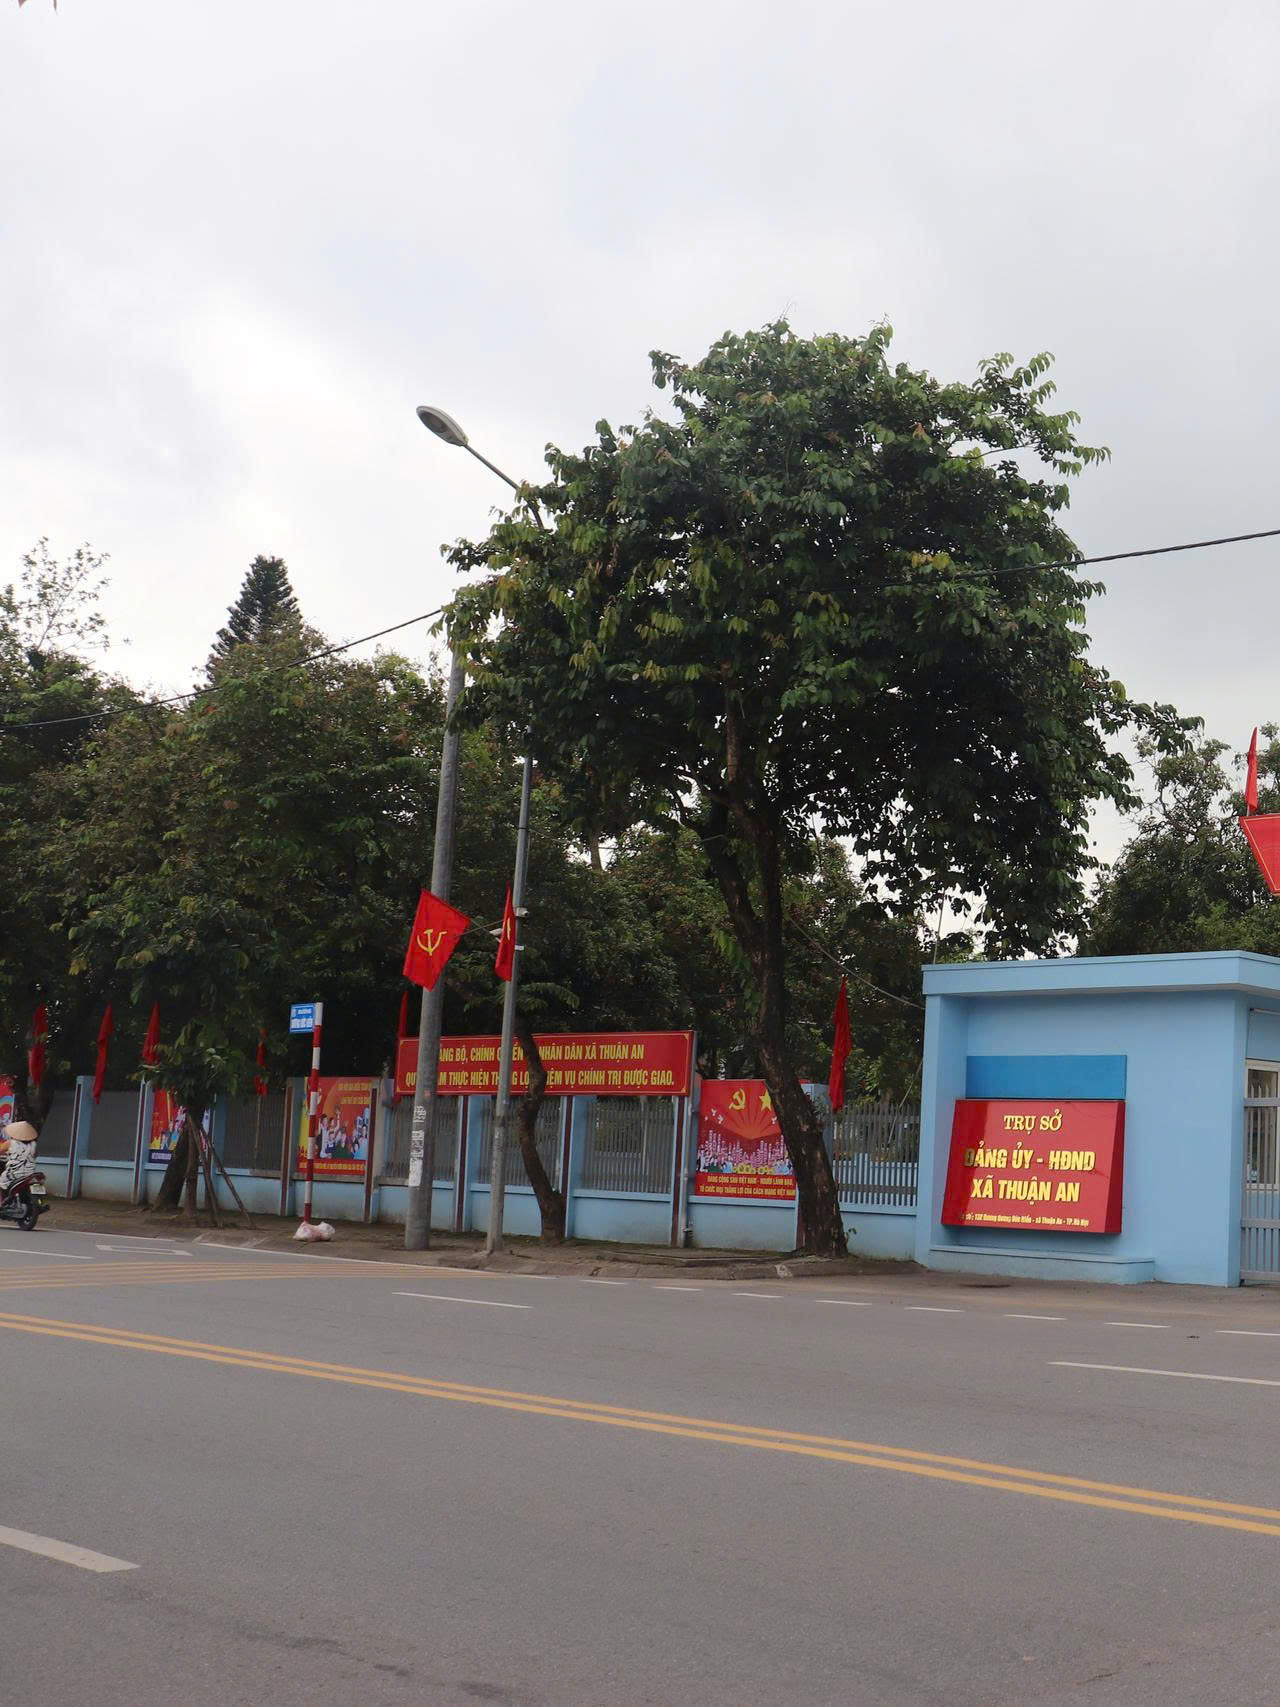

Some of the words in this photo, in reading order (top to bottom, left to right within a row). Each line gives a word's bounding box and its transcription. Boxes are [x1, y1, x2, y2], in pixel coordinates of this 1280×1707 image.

[440, 1043, 454, 1062] ẢNG
[470, 1045, 495, 1062] CHÍNH
[564, 1042, 582, 1060] DÂN
[585, 1042, 597, 1060] XÃ
[600, 1041, 628, 1063] THUẬN
[631, 1044, 645, 1059] AN
[470, 1068, 489, 1088] HIỆN
[565, 1071, 576, 1088] VỤ
[578, 1068, 606, 1086] CHÍNH
[608, 1070, 622, 1088] TRỊ
[624, 1068, 649, 1088] ĐƯỢC
[651, 1070, 675, 1086] GIAO.
[1003, 1115, 1036, 1135] TRỤ
[1040, 1108, 1062, 1131] SỞ
[1012, 1141, 1034, 1169] ỦY
[1048, 1150, 1096, 1171] HĐND
[970, 1174, 994, 1199] XÃ
[998, 1176, 1052, 1205] THUẬN
[1055, 1182, 1081, 1202] AN
